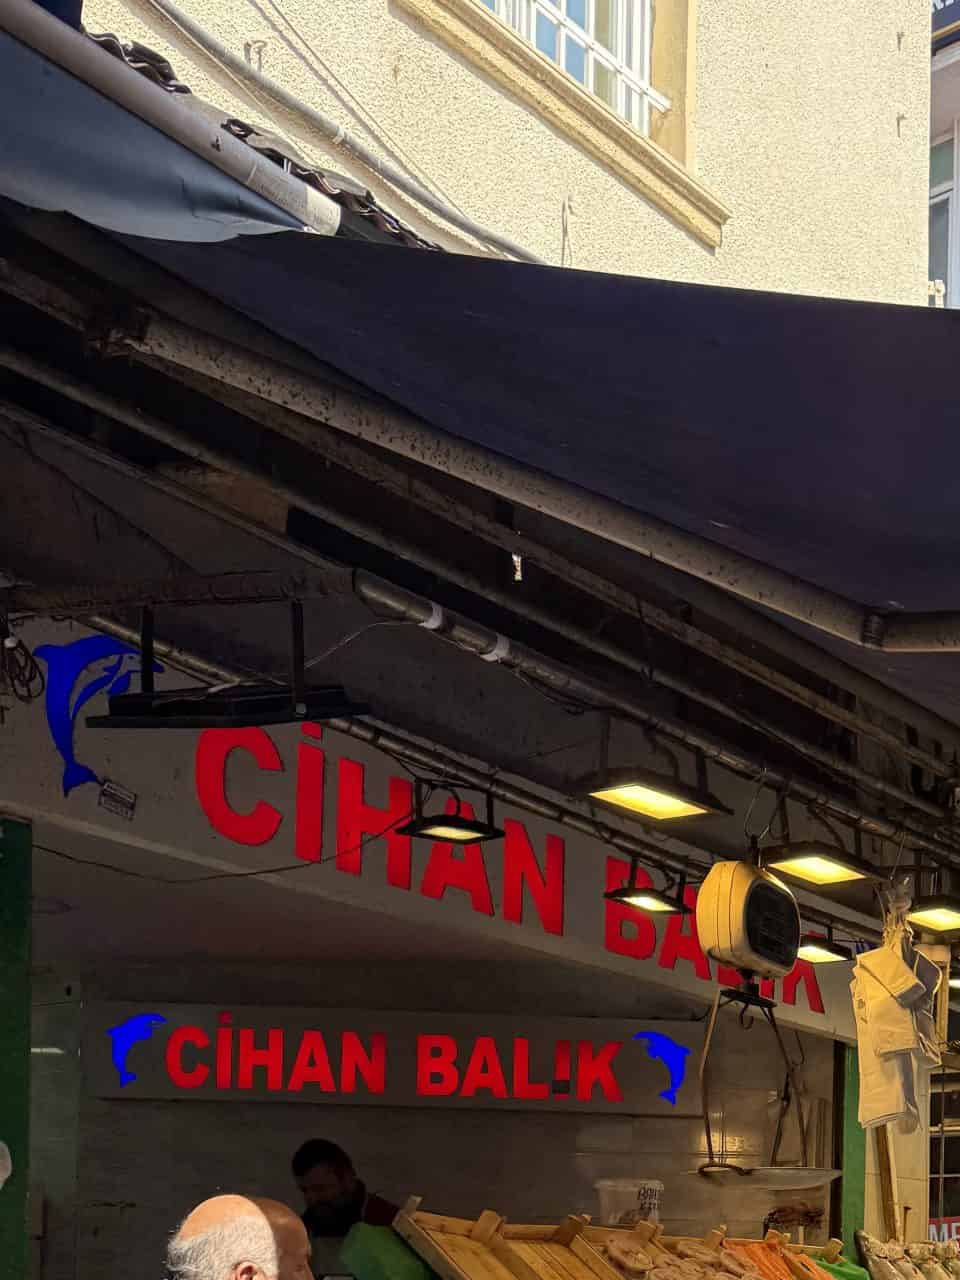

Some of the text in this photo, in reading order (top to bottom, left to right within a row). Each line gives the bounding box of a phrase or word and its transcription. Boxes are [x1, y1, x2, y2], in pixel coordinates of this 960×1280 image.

[195, 721, 825, 1014] CİHAN BAK
[165, 1011, 625, 1101] CİHAN BALIK
